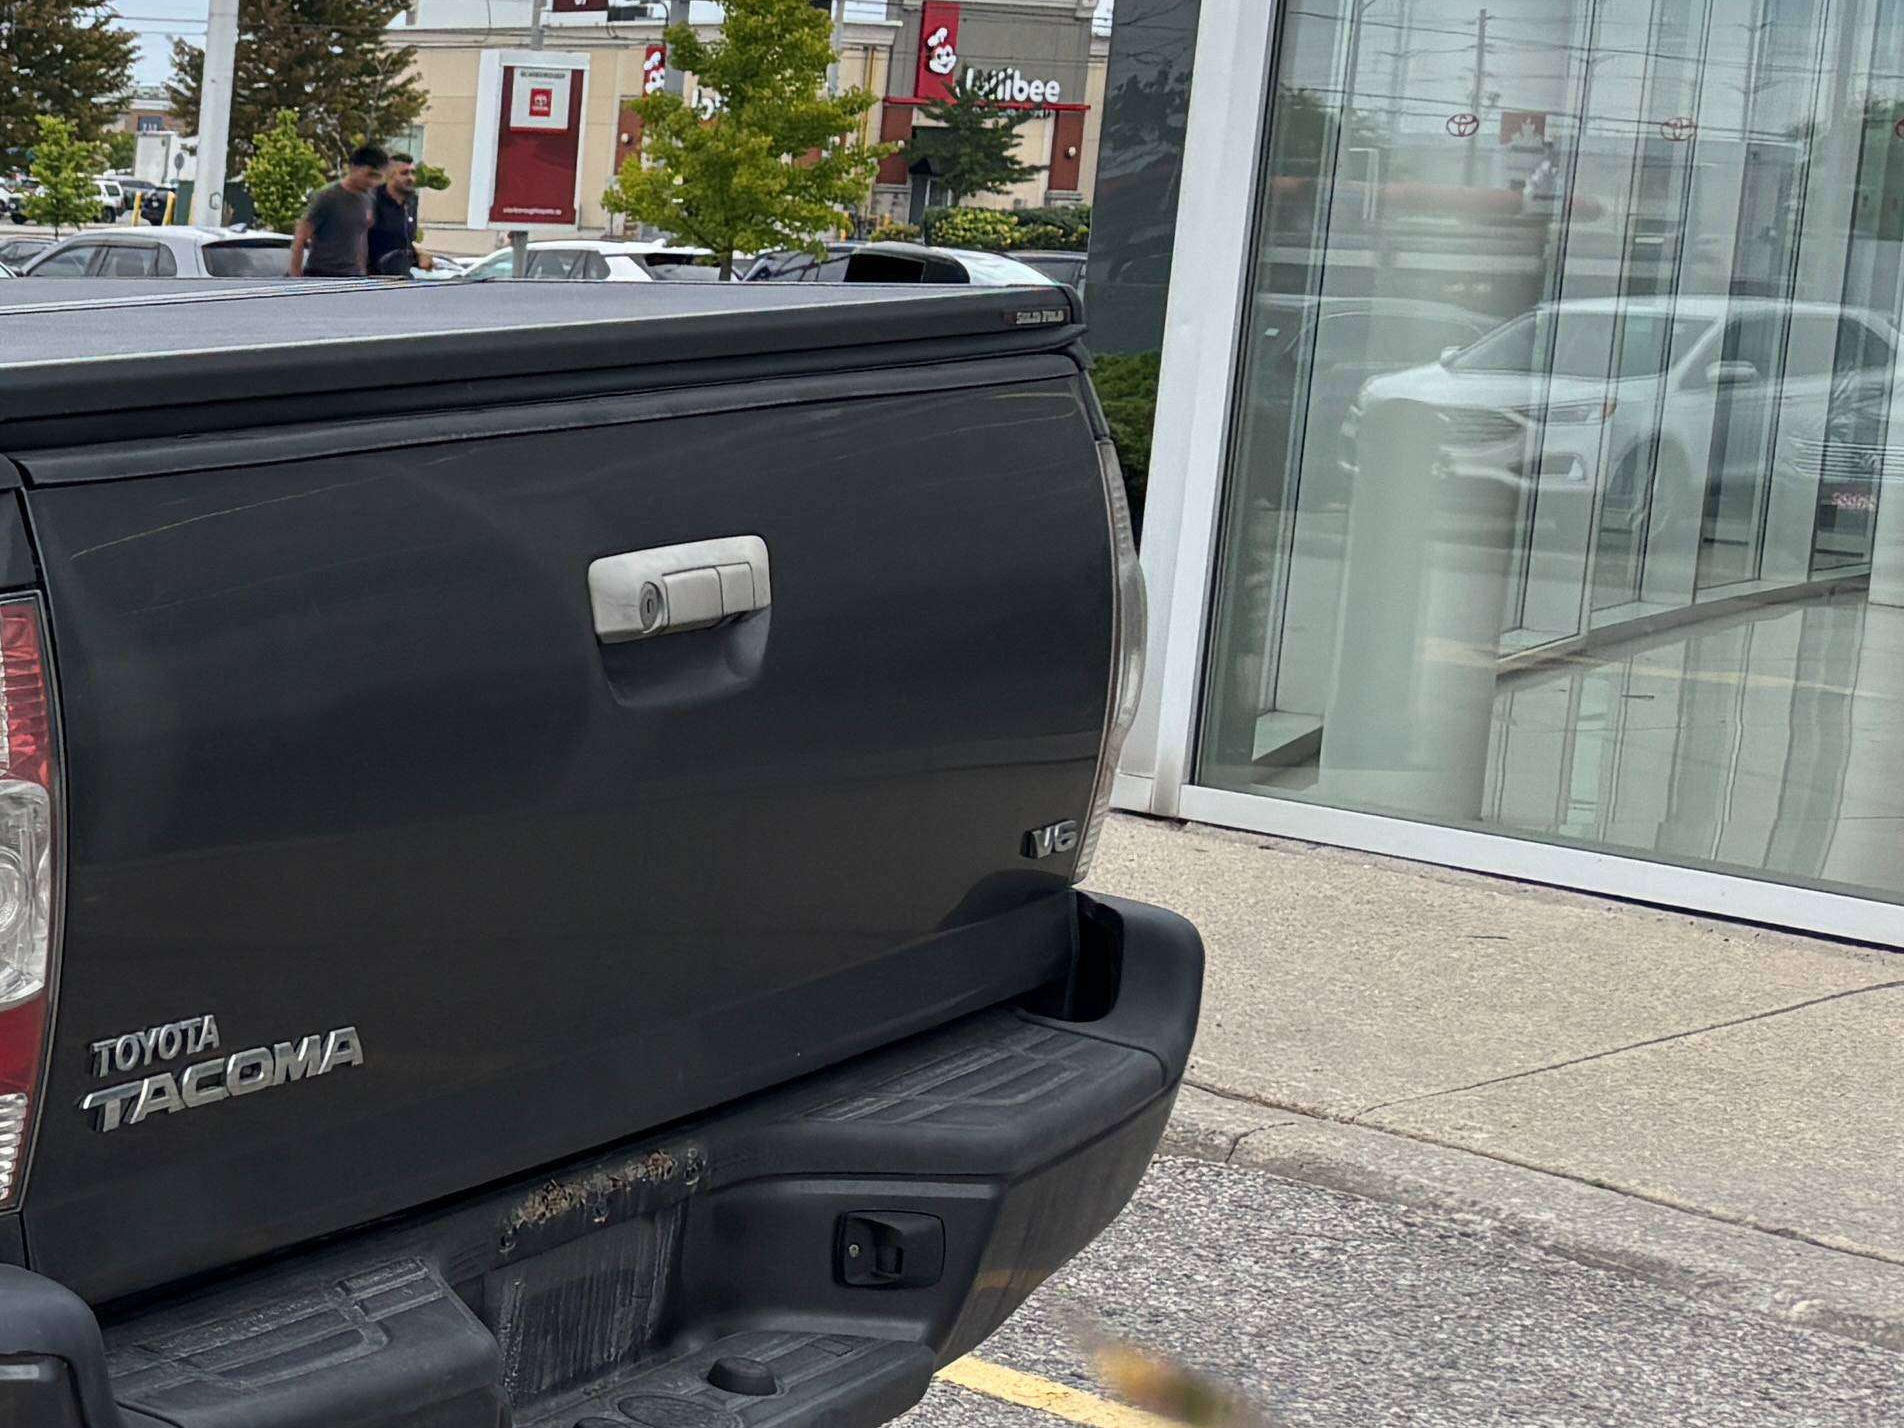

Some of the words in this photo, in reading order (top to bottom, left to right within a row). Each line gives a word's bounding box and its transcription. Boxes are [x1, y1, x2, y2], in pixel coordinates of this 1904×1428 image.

[1030, 819, 1078, 860] V6
[92, 1014, 221, 1078] TOYOTA
[78, 1026, 364, 1133] TACOMA
